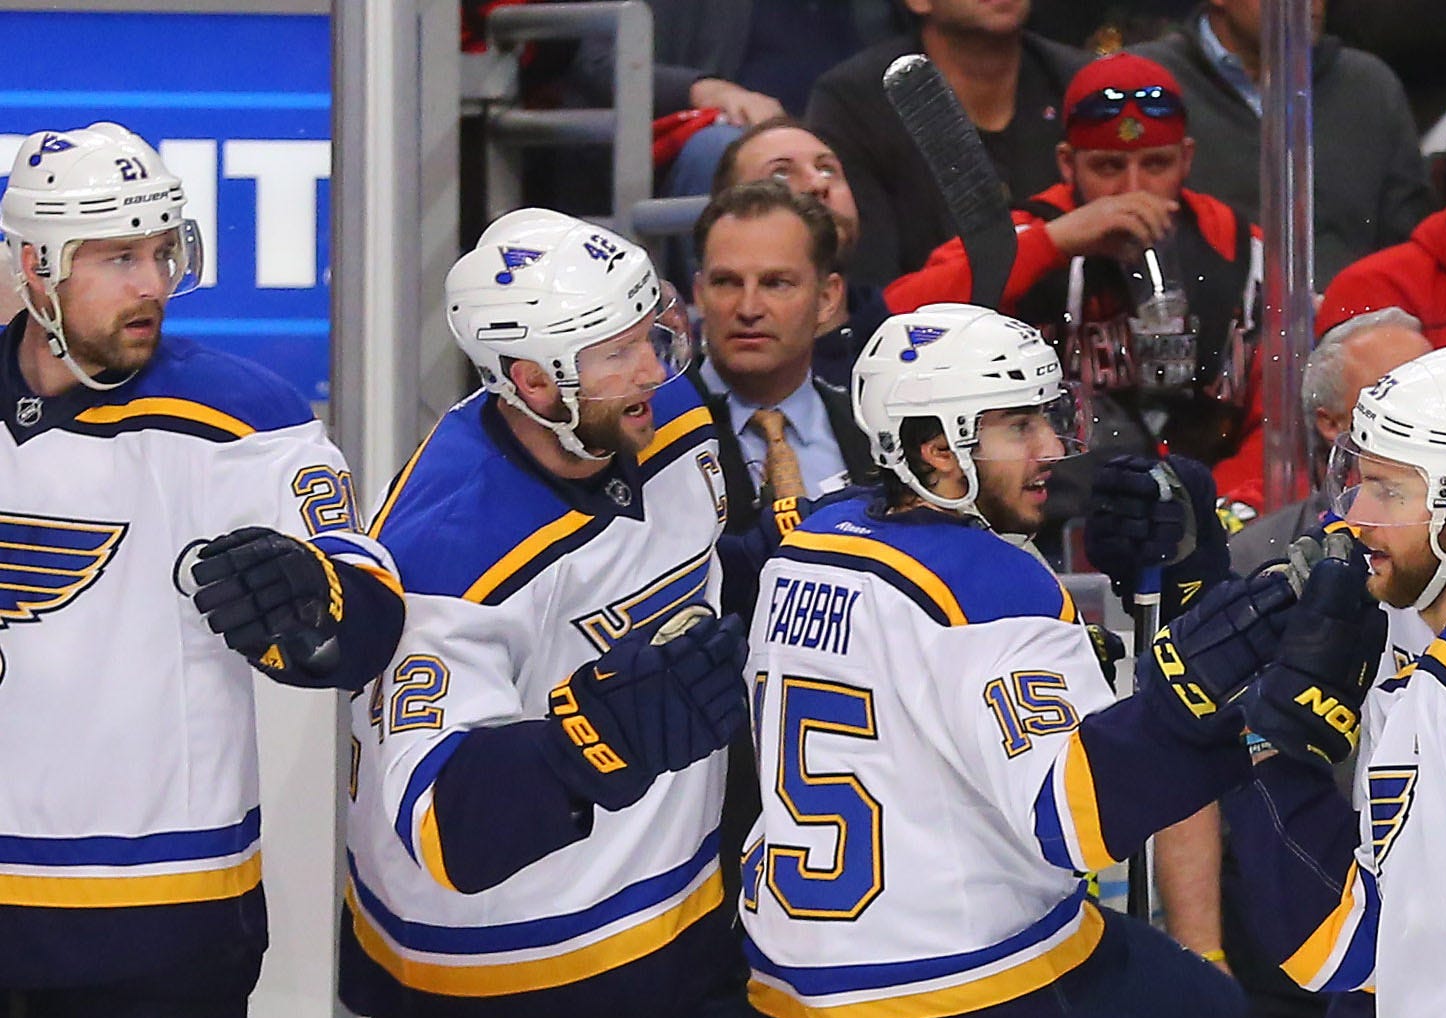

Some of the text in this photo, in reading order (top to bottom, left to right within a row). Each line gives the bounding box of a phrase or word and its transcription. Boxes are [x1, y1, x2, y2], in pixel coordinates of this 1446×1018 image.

[115, 156, 148, 181] 21
[583, 234, 617, 261] 42
[291, 464, 365, 537] 21
[695, 450, 728, 523] C
[765, 577, 862, 655] FABBRI
[370, 654, 450, 744] 42
[983, 670, 1081, 760] 15
[741, 671, 886, 922] 15
